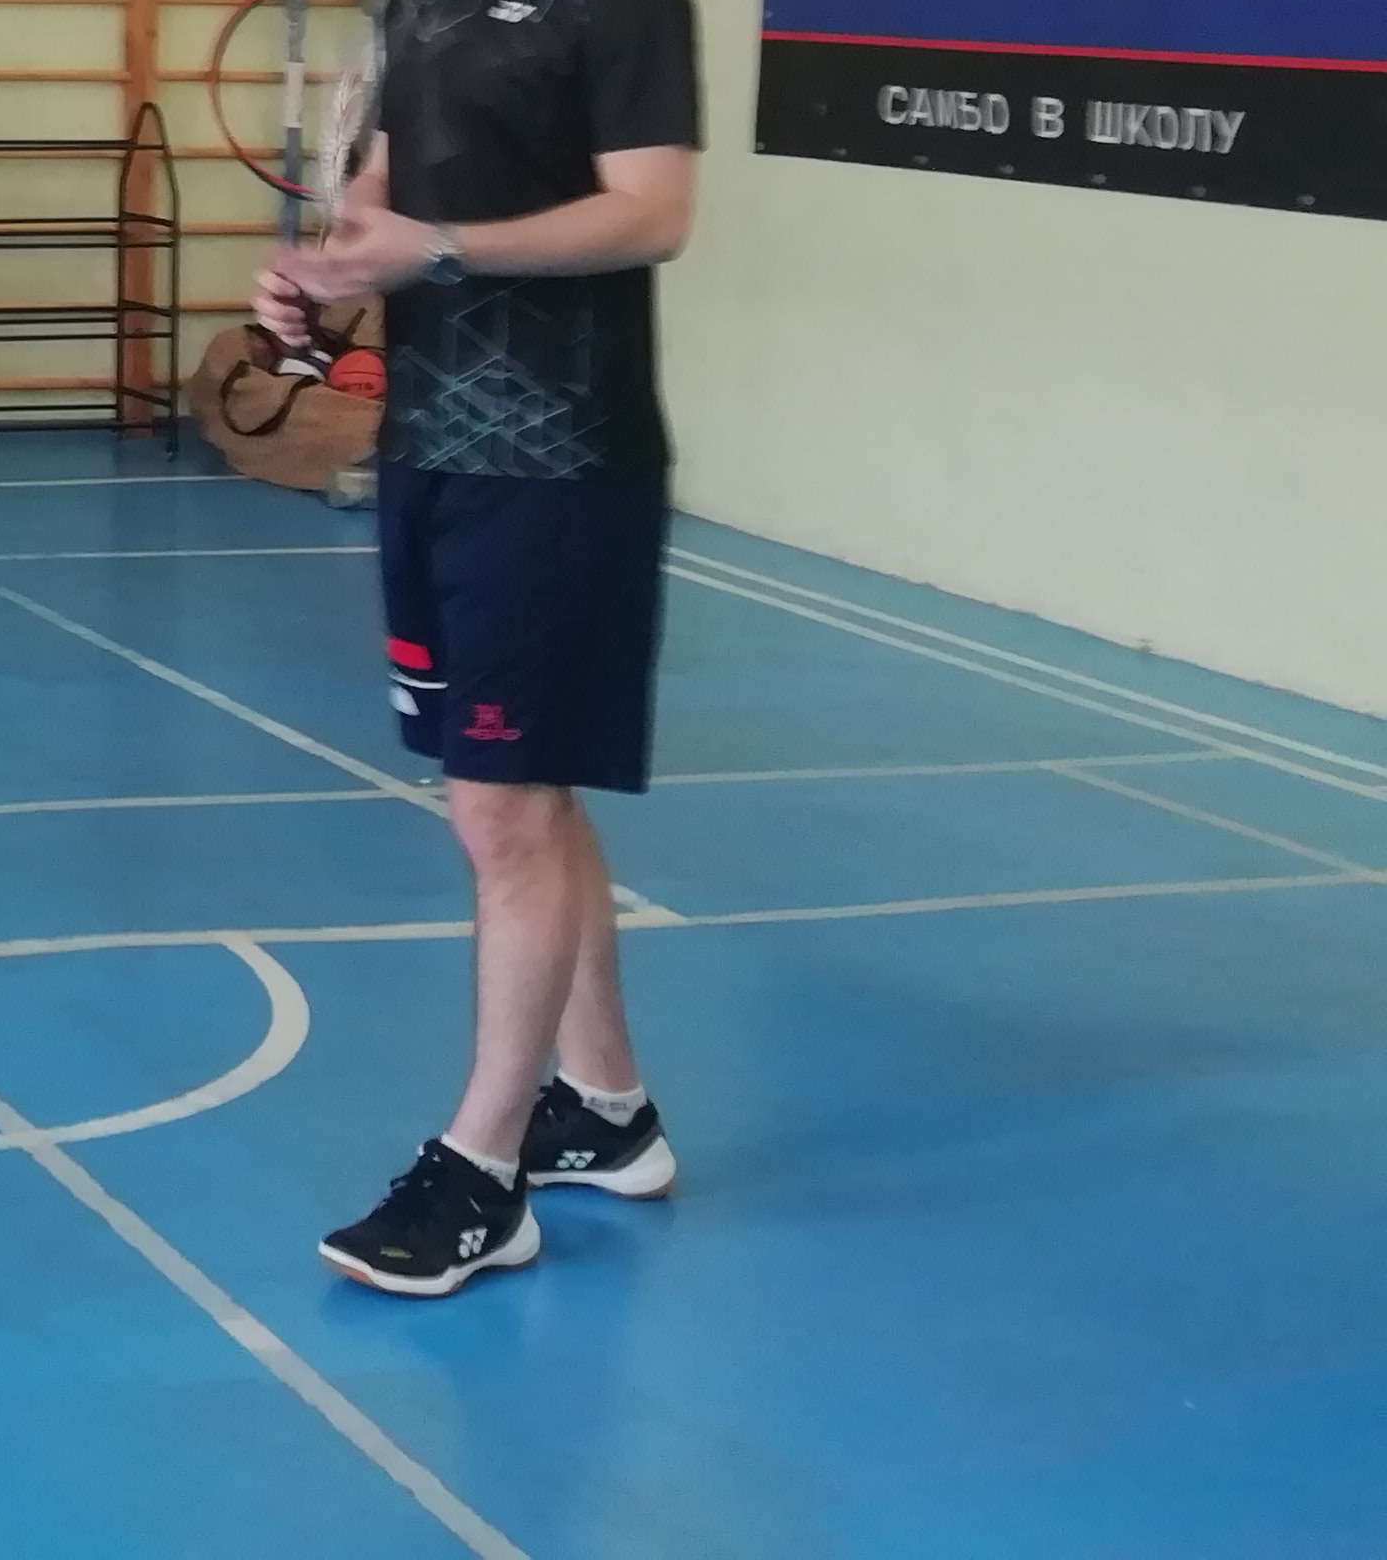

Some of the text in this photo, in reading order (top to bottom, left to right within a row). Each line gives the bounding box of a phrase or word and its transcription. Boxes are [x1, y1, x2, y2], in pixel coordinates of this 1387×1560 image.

[877, 85, 1247, 154] САМБО В ШКОЛУ
